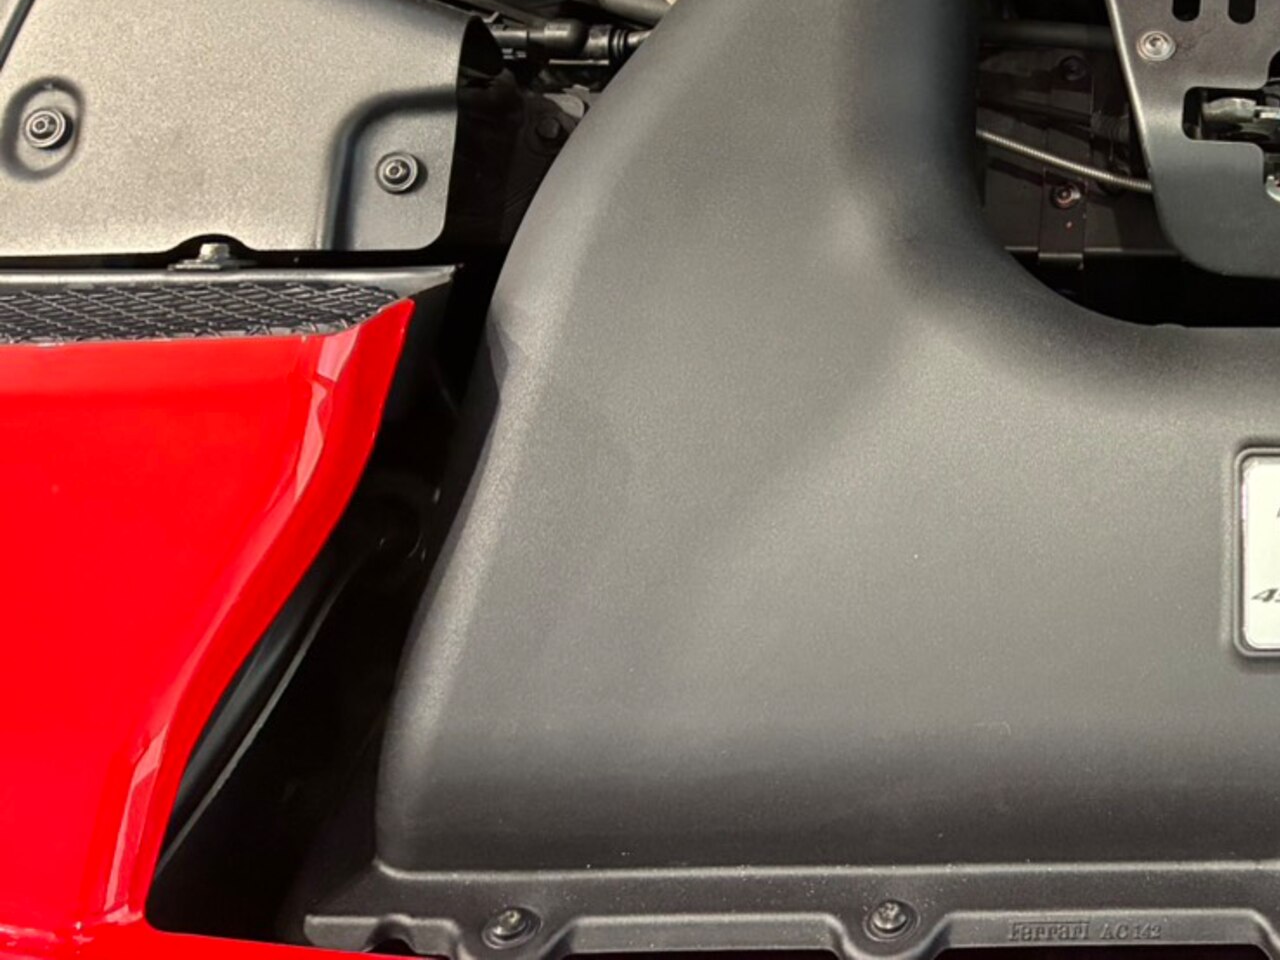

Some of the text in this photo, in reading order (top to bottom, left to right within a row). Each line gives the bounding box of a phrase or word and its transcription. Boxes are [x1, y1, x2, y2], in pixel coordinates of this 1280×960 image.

[1009, 921, 1162, 941] Ferrari AC 142
